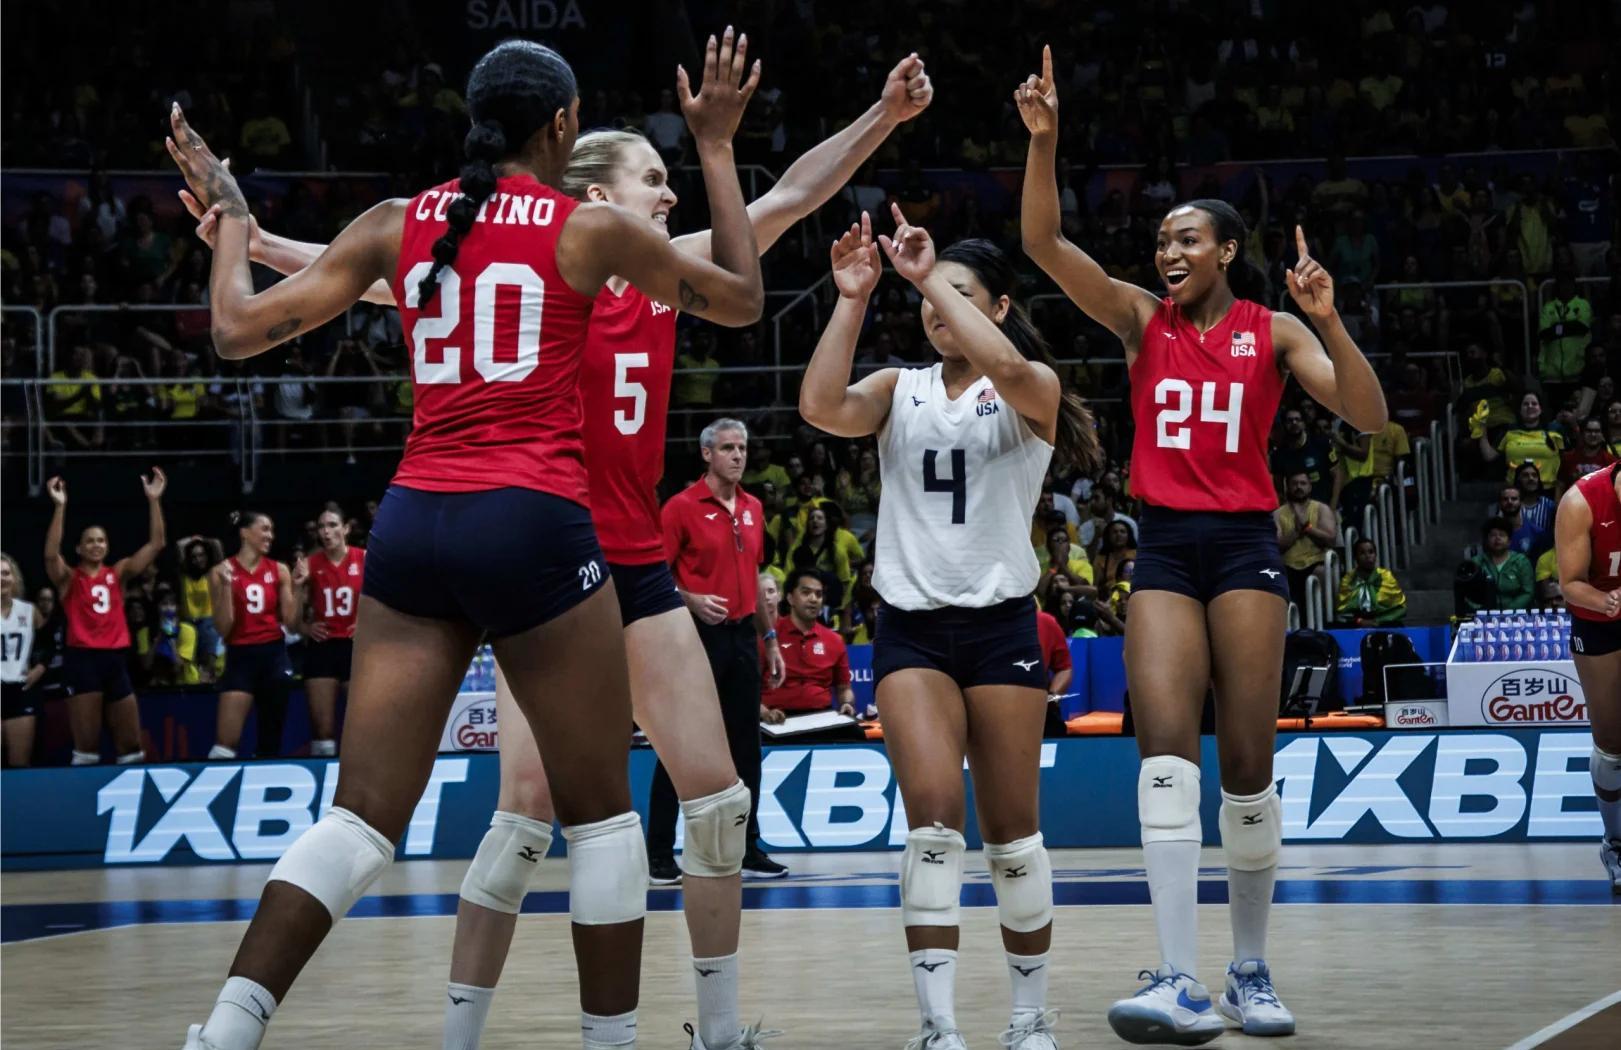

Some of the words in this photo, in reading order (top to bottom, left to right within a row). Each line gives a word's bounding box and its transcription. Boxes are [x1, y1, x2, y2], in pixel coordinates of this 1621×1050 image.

[466, 0, 587, 29] SAIDA
[415, 190, 556, 226] CUTINO
[403, 261, 545, 384] 20
[1230, 344, 1256, 357] USA
[613, 352, 650, 436] 5
[975, 401, 1000, 417] USA
[1154, 377, 1244, 453] 24
[922, 448, 967, 525] 4
[578, 560, 601, 591] 20
[91, 584, 111, 614] 3
[245, 583, 265, 614] 9
[323, 586, 353, 617] 13
[1501, 677, 1568, 696] 百岁山
[96, 757, 470, 864] 1XBT
